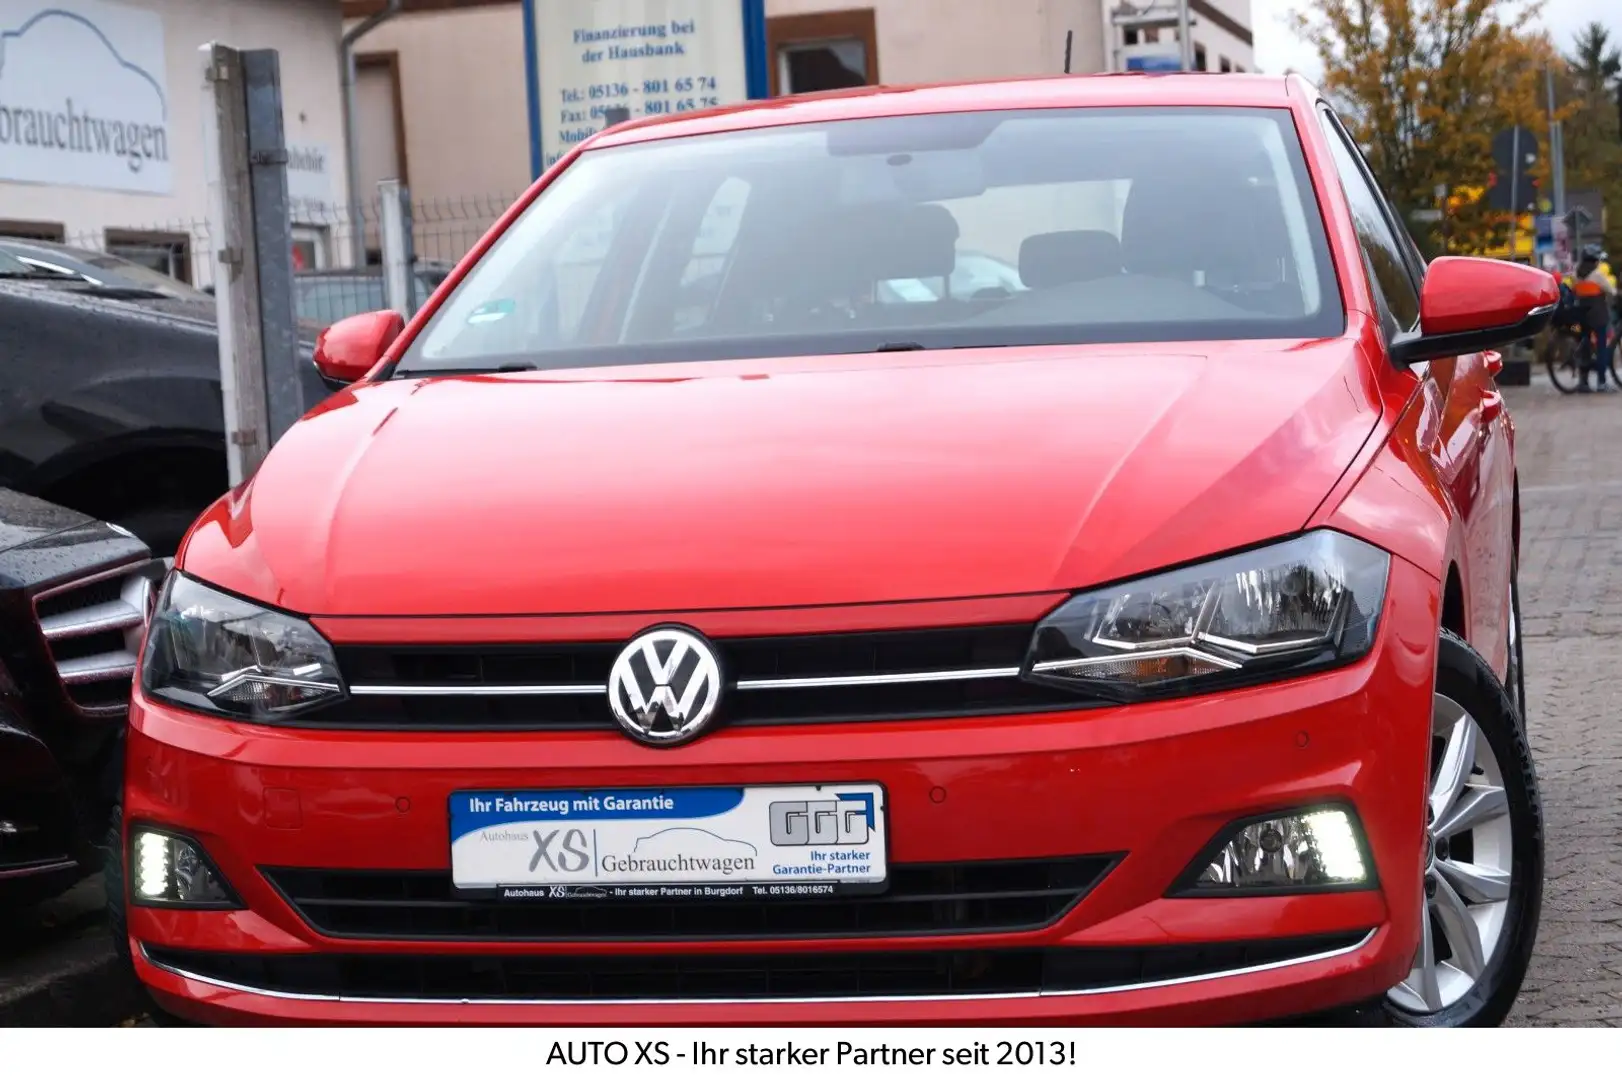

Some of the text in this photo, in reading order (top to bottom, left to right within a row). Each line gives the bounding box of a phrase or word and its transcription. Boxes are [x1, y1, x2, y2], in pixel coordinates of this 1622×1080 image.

[573, 19, 694, 44] Finanzierung bei
[582, 42, 685, 63] der Hausbank
[588, 82, 628, 99] 05136
[642, 79, 669, 94] 801
[674, 76, 693, 92] 65
[697, 76, 716, 91] 74
[644, 99, 670, 114] 801
[469, 796, 674, 815] Ihr Fahrzeug mit Garantie
[480, 830, 529, 841] Autohaus
[529, 828, 590, 872] XS
[810, 849, 871, 861] Ihr starker
[602, 853, 755, 875] Gebrauchtwagen
[772, 864, 871, 875] Garantie-Partner
[504, 889, 544, 897] Autohaus
[548, 885, 565, 898] XS
[615, 888, 627, 896] Ihr
[628, 887, 659, 896] starker
[660, 887, 692, 896] Partner
[694, 887, 703, 895] in
[704, 886, 743, 896] Burgdorf
[752, 886, 768, 895] Tel.
[769, 885, 833, 894] 05136/8016574
